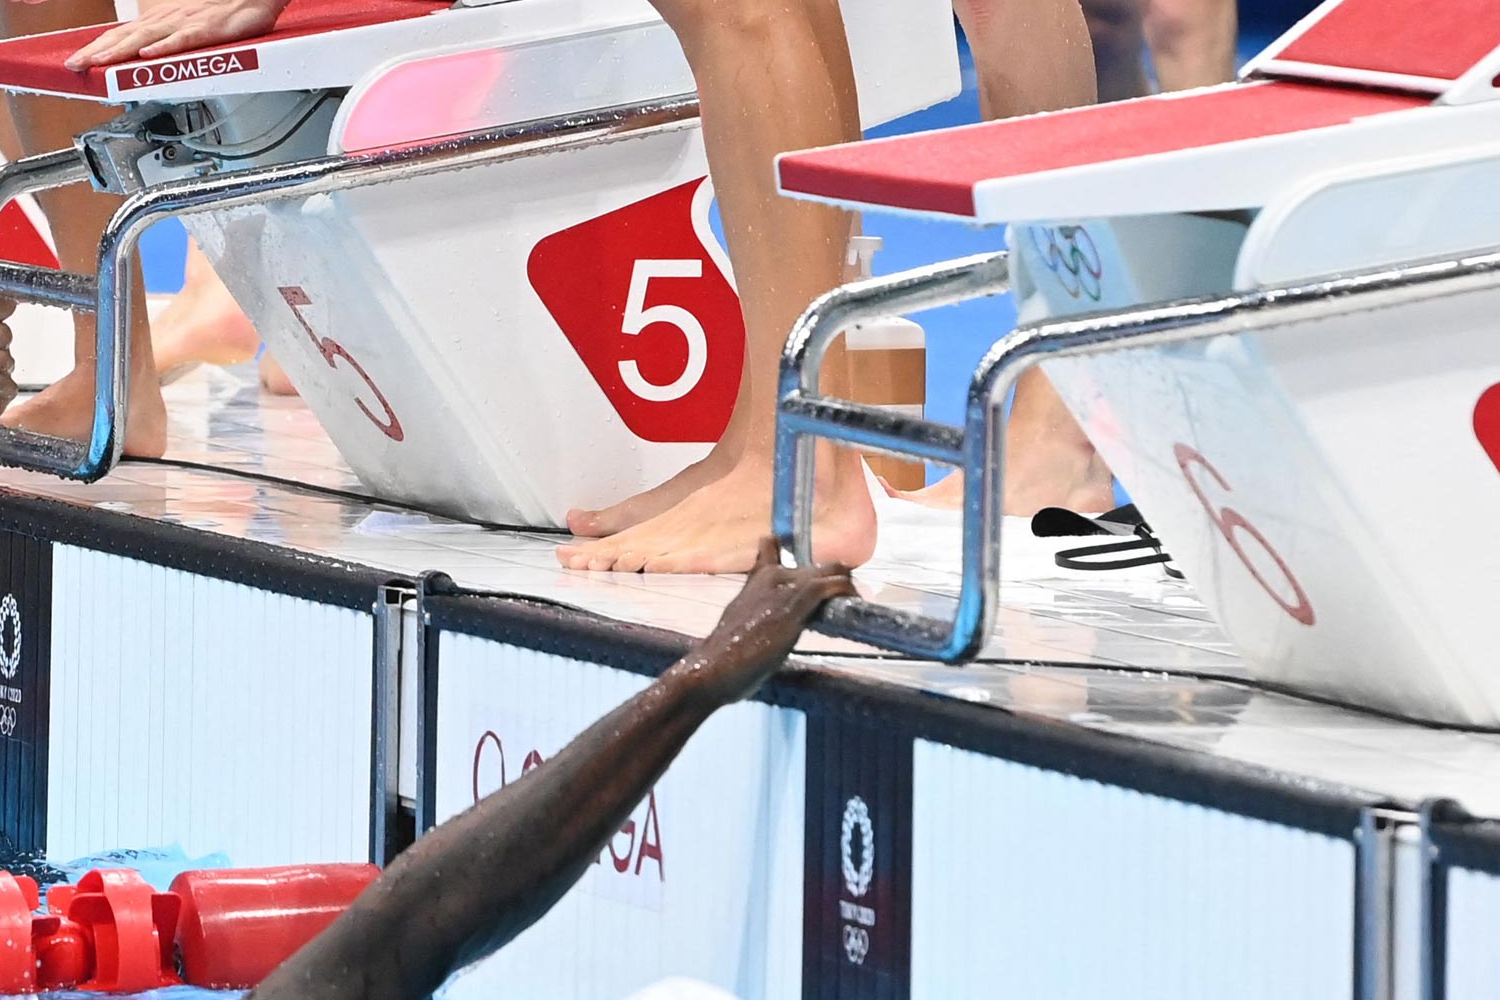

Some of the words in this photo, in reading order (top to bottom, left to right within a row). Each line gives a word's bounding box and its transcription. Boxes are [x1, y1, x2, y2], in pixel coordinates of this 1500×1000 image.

[159, 53, 244, 82] OMEGA
[277, 286, 405, 442] 5
[617, 259, 708, 401] 5
[1173, 442, 1316, 626] 6
